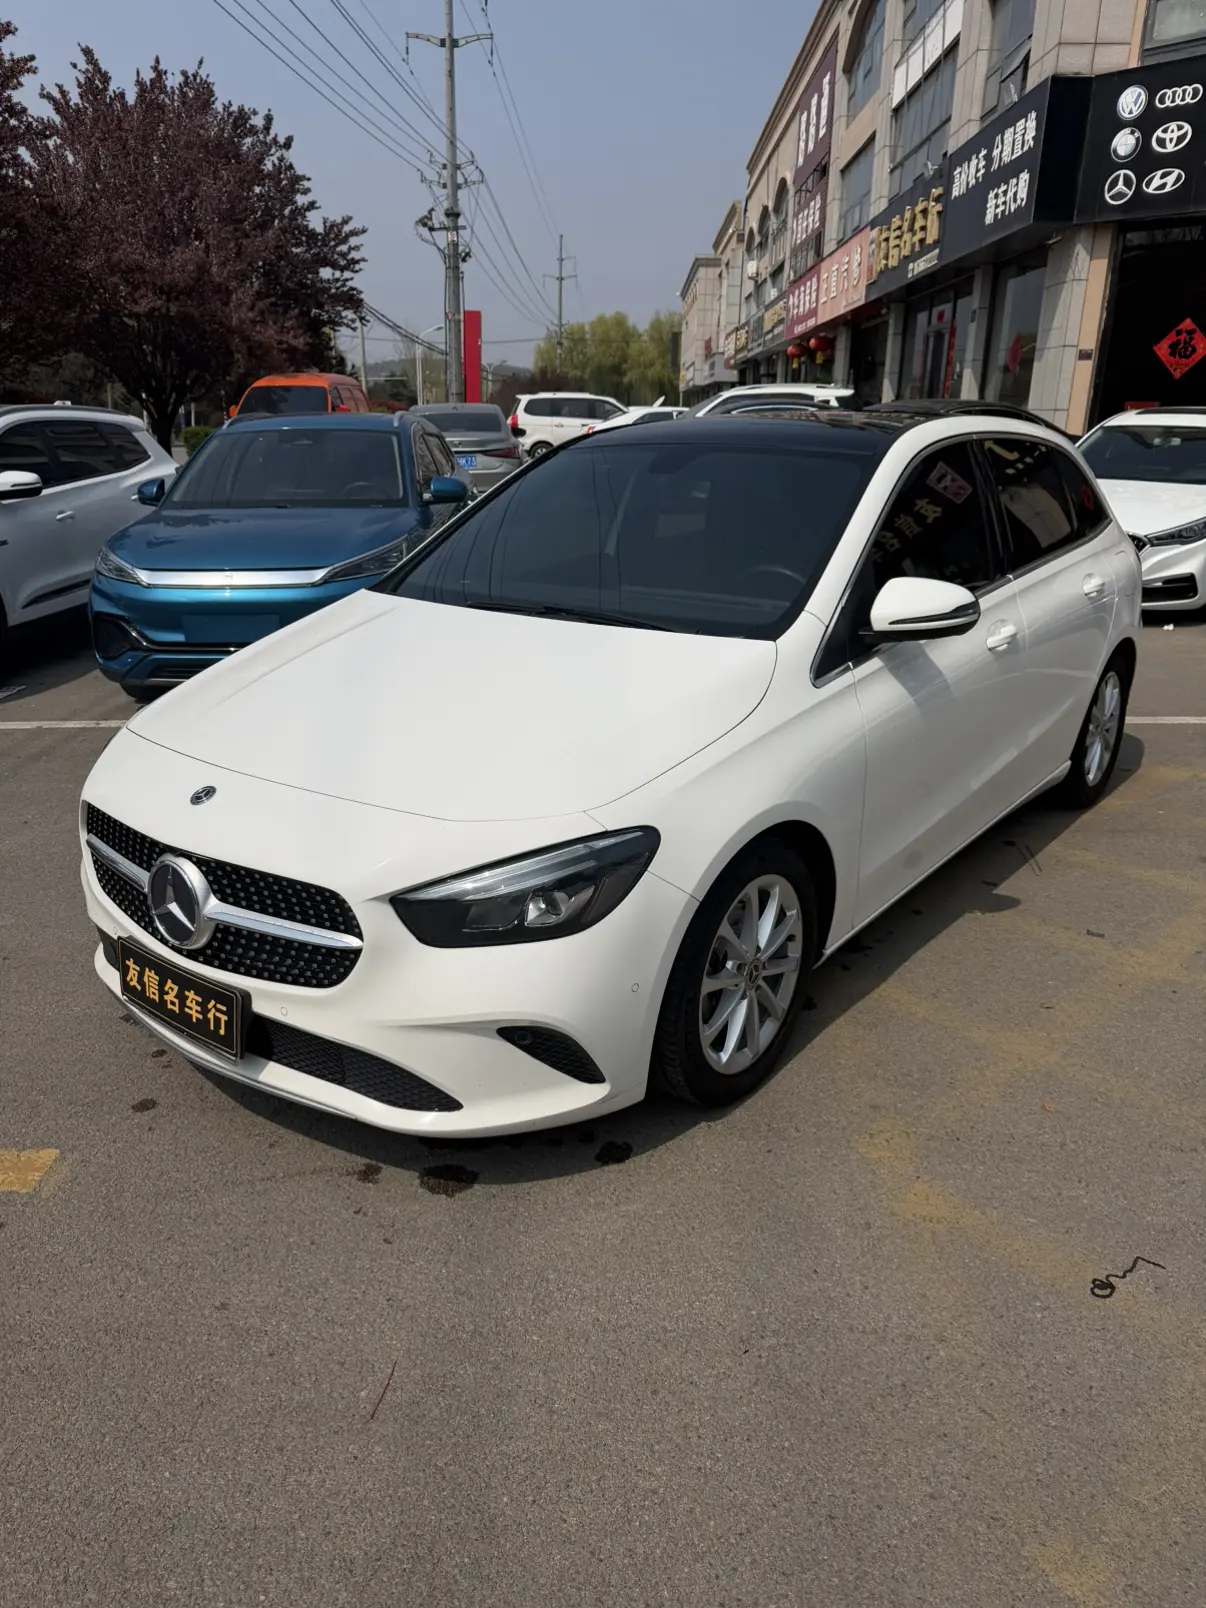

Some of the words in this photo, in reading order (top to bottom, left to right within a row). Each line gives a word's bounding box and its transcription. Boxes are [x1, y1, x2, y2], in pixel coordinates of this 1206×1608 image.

[951, 147, 988, 200] 高价收车
[990, 110, 1037, 173] 分期置换
[984, 168, 1030, 226] 新车代购
[1168, 328, 1197, 360] 福
[124, 957, 229, 1037] 友信名车行
